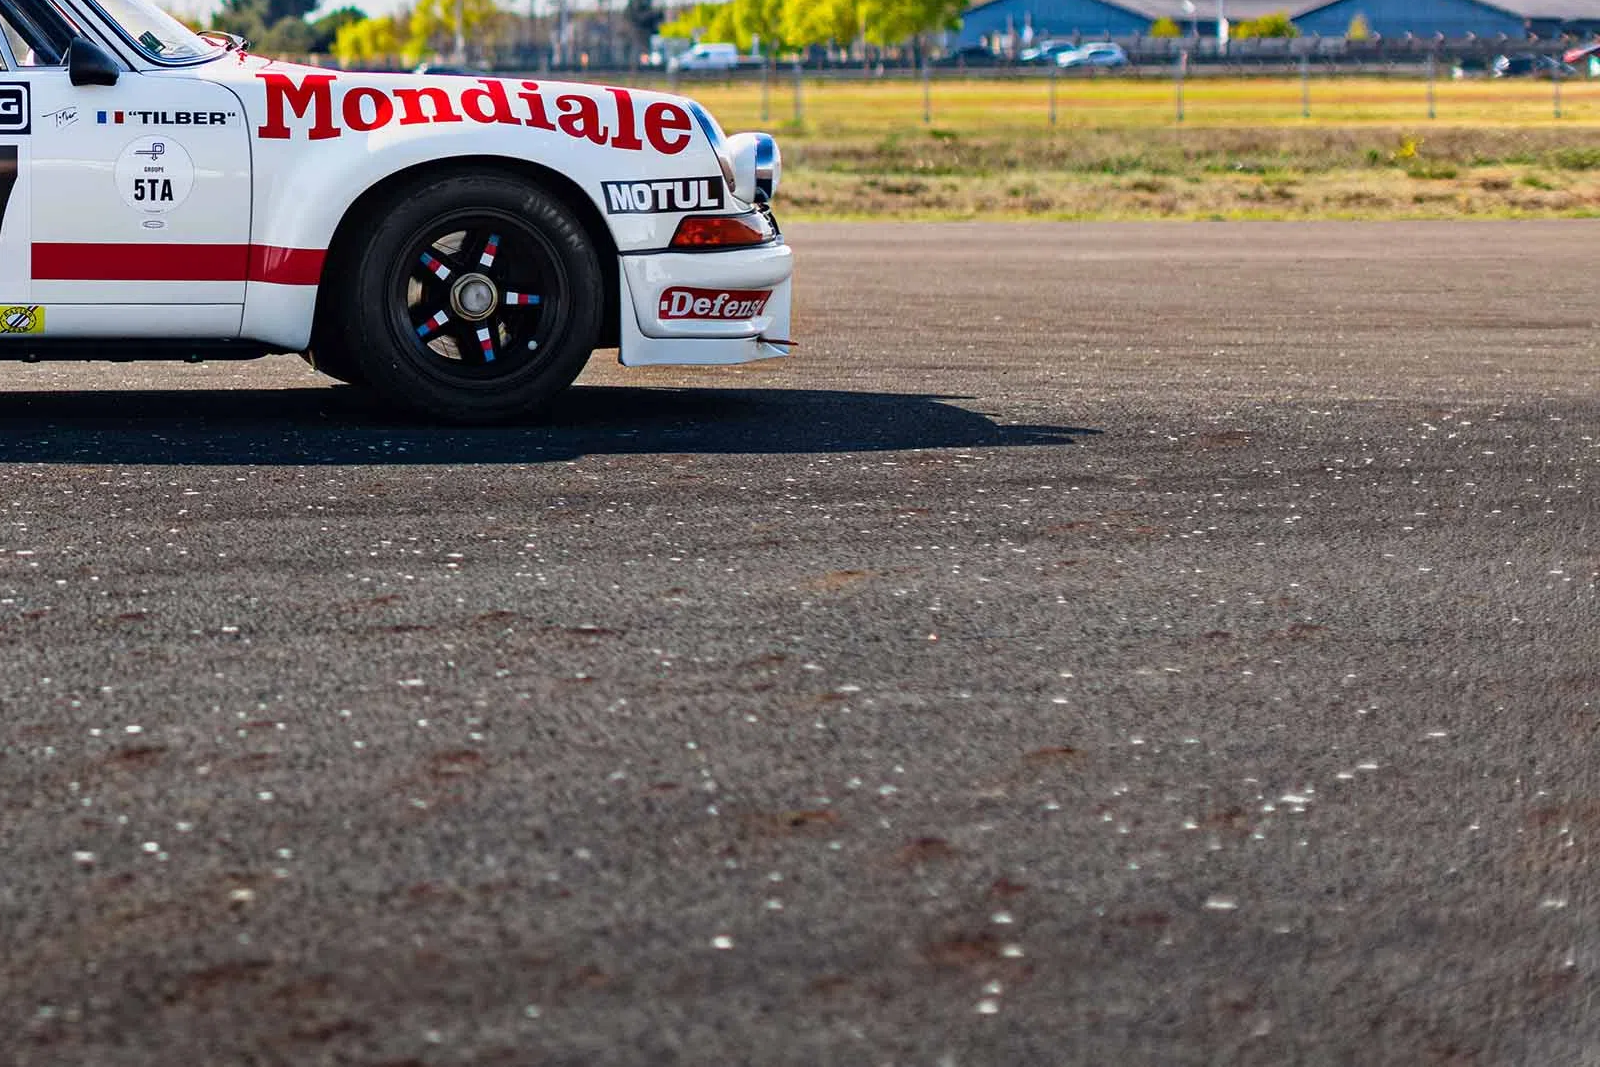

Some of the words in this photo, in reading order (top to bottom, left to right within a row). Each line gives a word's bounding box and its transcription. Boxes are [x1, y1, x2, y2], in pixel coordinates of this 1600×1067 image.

[255, 73, 693, 155] Mondiale
[134, 179, 174, 201] 5TA
[607, 180, 719, 211] MOTUL
